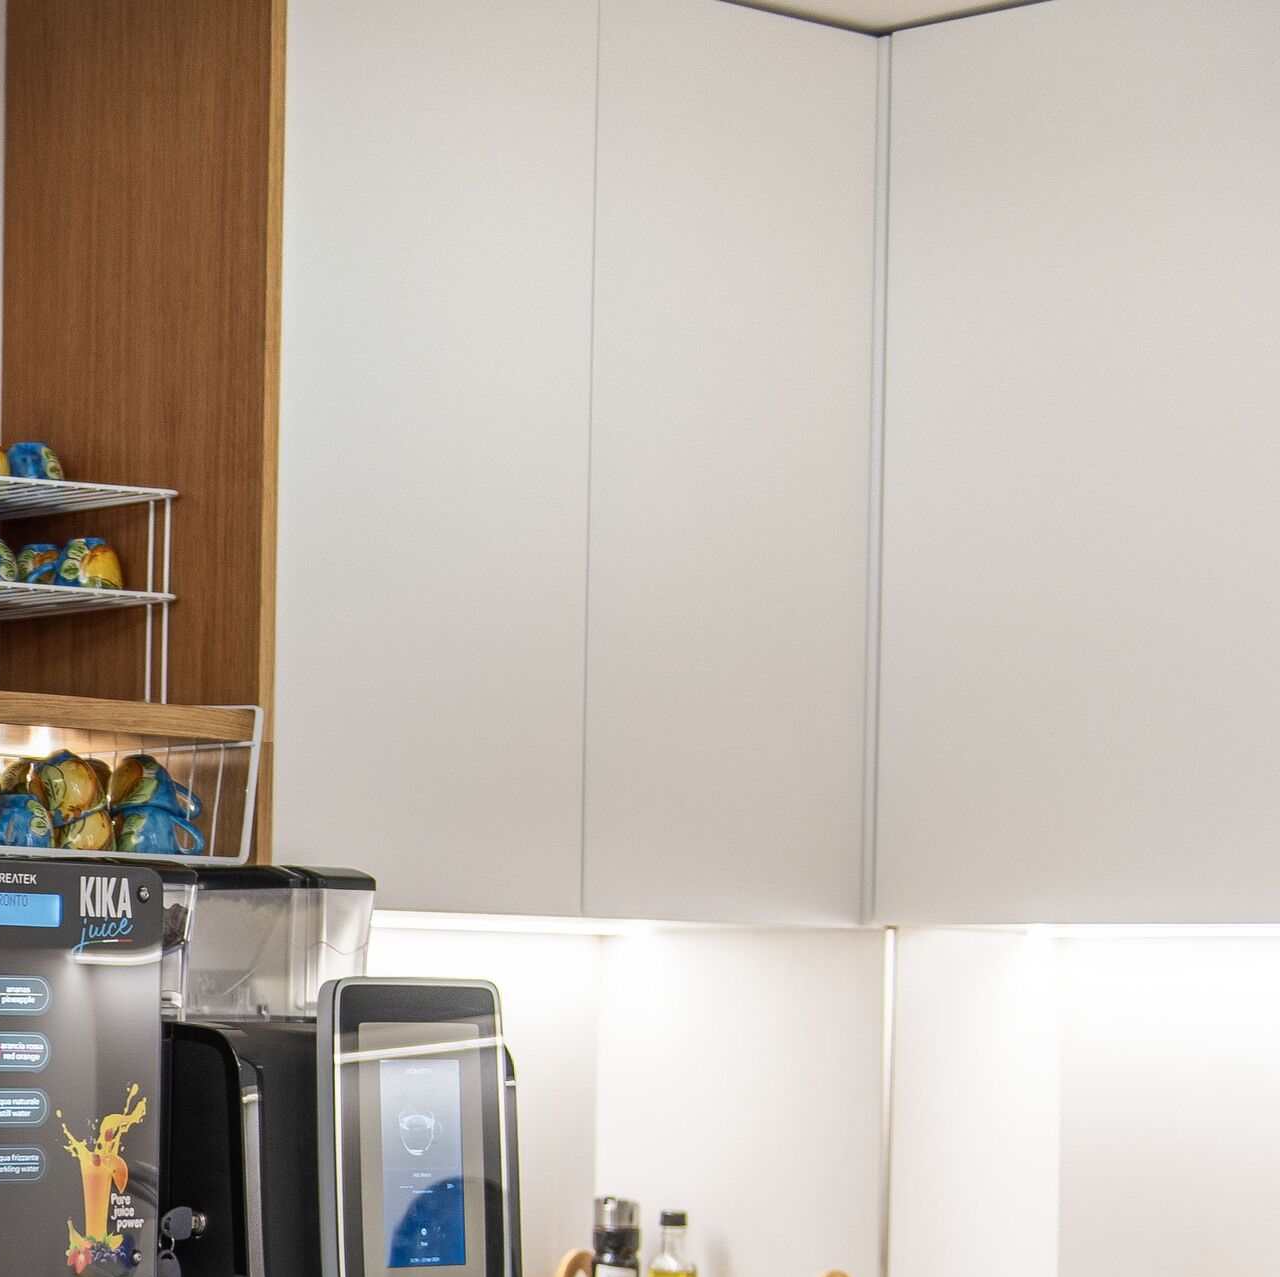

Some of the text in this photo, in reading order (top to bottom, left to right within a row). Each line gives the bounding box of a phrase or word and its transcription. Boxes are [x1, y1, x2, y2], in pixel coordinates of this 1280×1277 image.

[80, 876, 133, 918] KIKA
[70, 916, 133, 954] juice
[3, 1052, 40, 1062] red orange
[12, 1097, 40, 1106] naturale
[0, 1109, 11, 1117] still
[110, 1192, 131, 1206] Pure
[111, 1205, 135, 1220] juice
[116, 1218, 144, 1232] power
